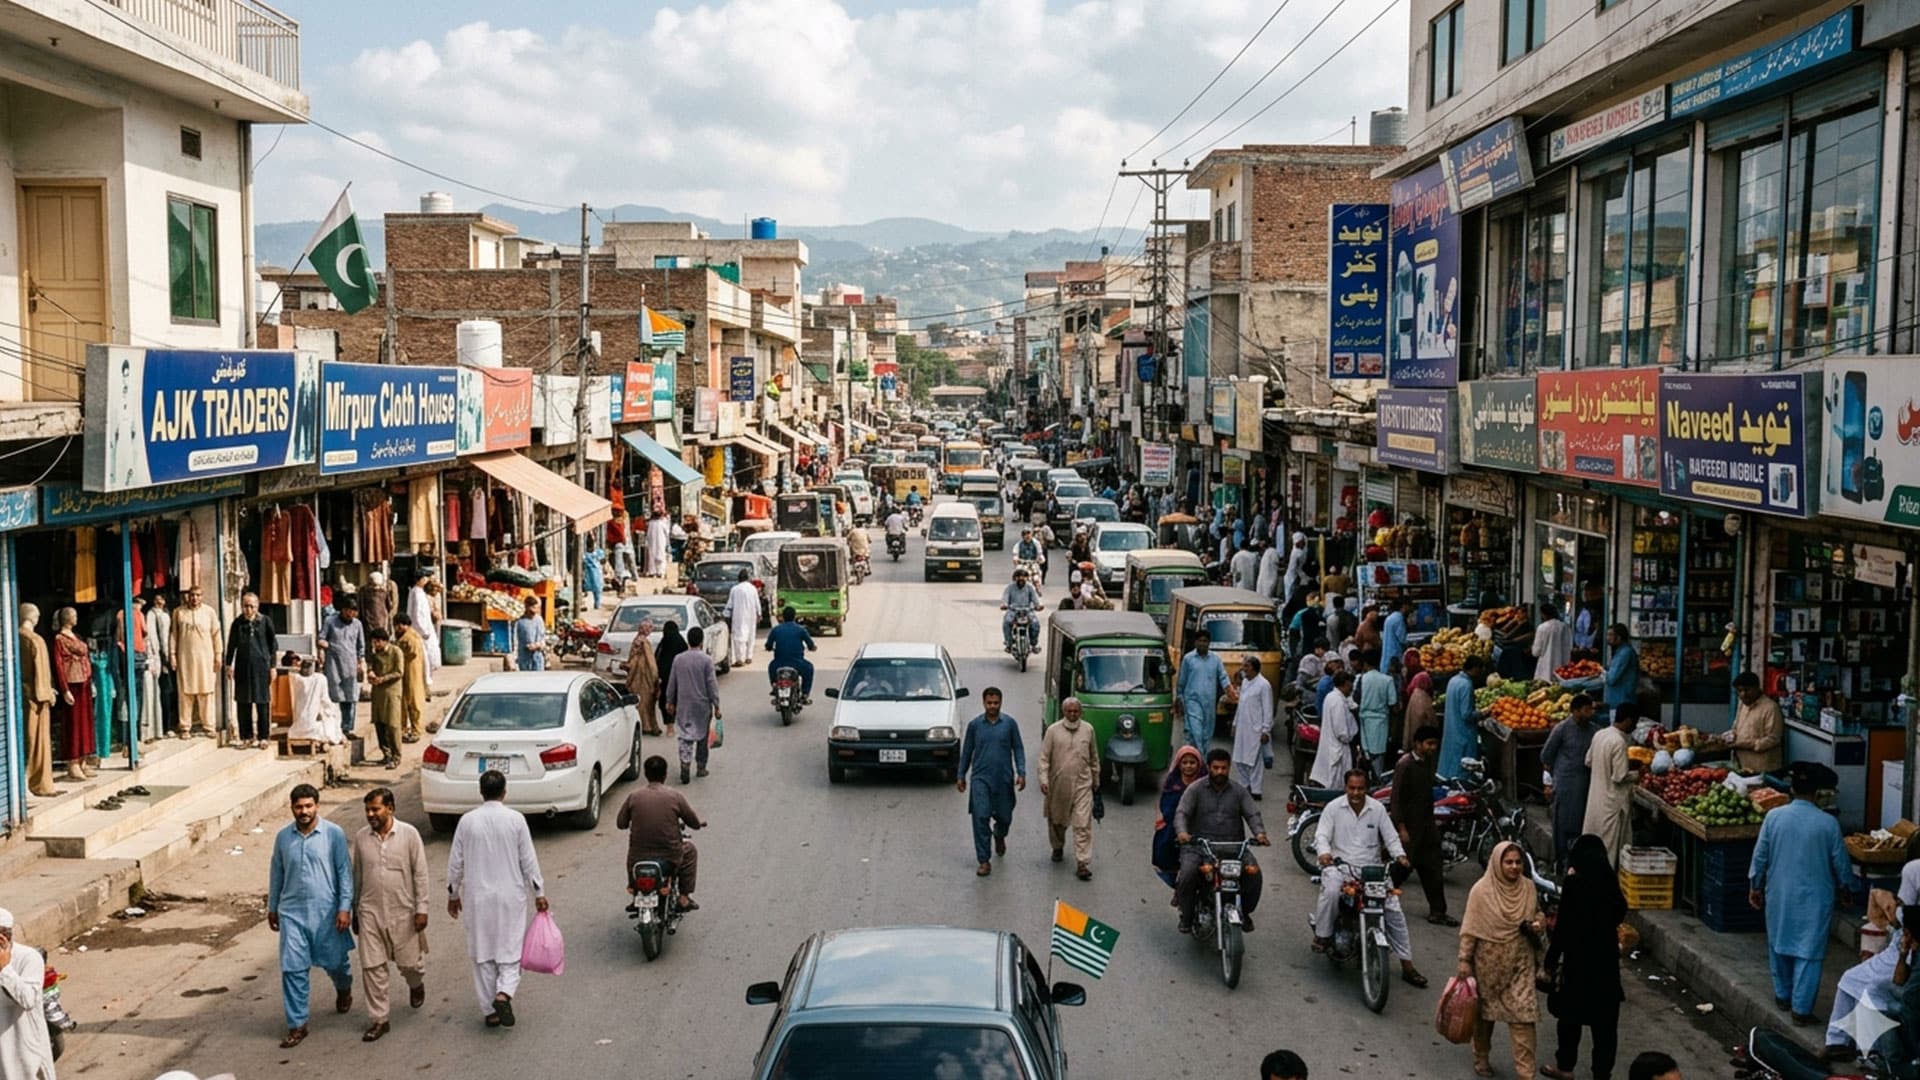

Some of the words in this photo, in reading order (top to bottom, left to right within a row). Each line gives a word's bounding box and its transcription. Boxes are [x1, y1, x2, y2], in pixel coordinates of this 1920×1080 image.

[150, 389, 199, 442] AJK
[202, 387, 289, 438] TRADERS
[325, 381, 376, 441] Mirpur
[380, 381, 415, 428] Cloth
[419, 382, 455, 425] House
[1667, 400, 1734, 442] Naveed
